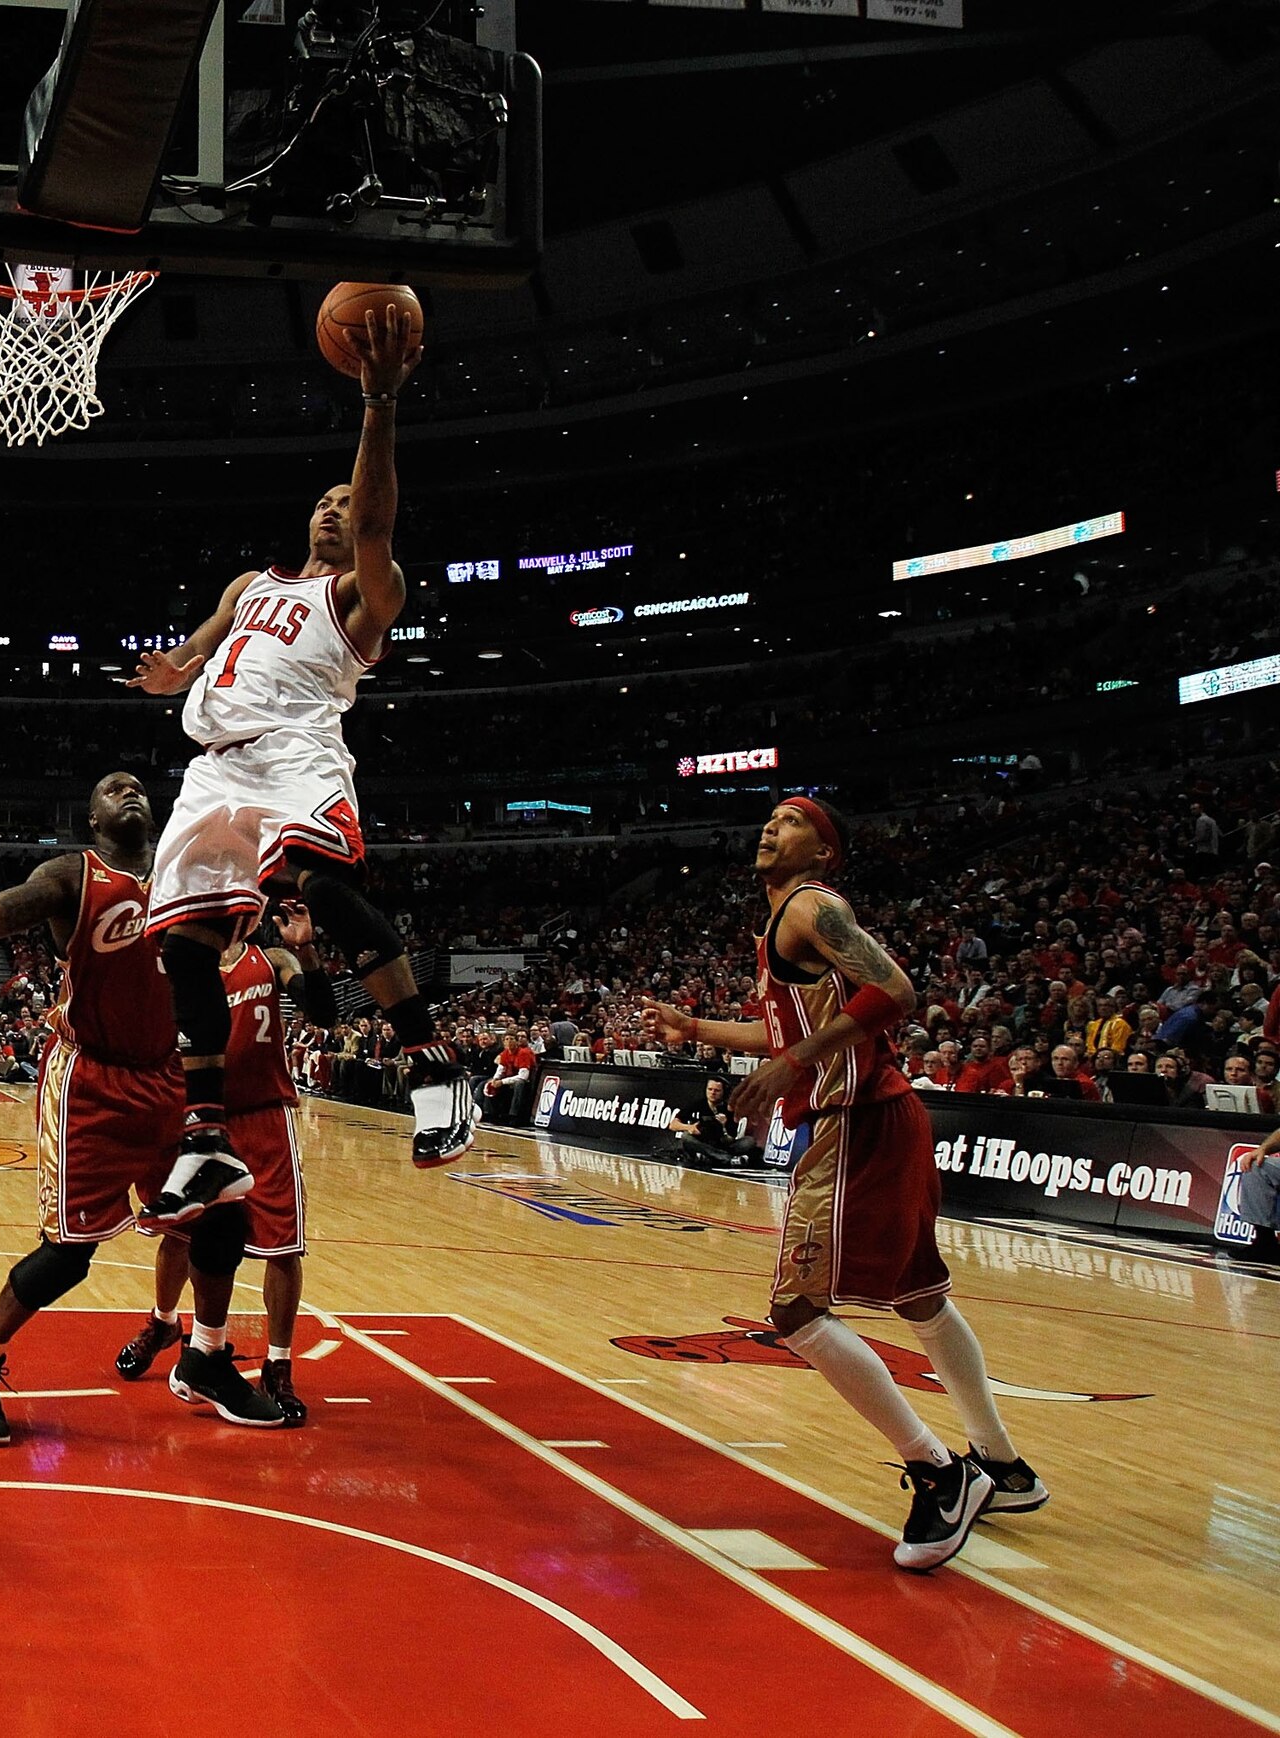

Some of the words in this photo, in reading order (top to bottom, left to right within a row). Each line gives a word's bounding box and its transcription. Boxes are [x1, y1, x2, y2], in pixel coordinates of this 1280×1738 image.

[519, 555, 566, 569] MAXWELL
[568, 553, 577, 564] &
[578, 551, 599, 562] JILL
[601, 546, 632, 560] SCOTT
[231, 597, 311, 646] ULLS
[634, 592, 749, 617] CSNCHICAGO.COM
[391, 626, 425, 641] CLUB
[214, 635, 252, 687] 1
[697, 748, 777, 774] AZTECA
[474, 964, 503, 975] verizon
[254, 1005, 271, 1042] 2
[765, 1000, 784, 1048] 15
[559, 1089, 619, 1123] Connect
[620, 1097, 640, 1124] at
[935, 1134, 966, 1172] at
[969, 1136, 1192, 1207] iHoops.com
